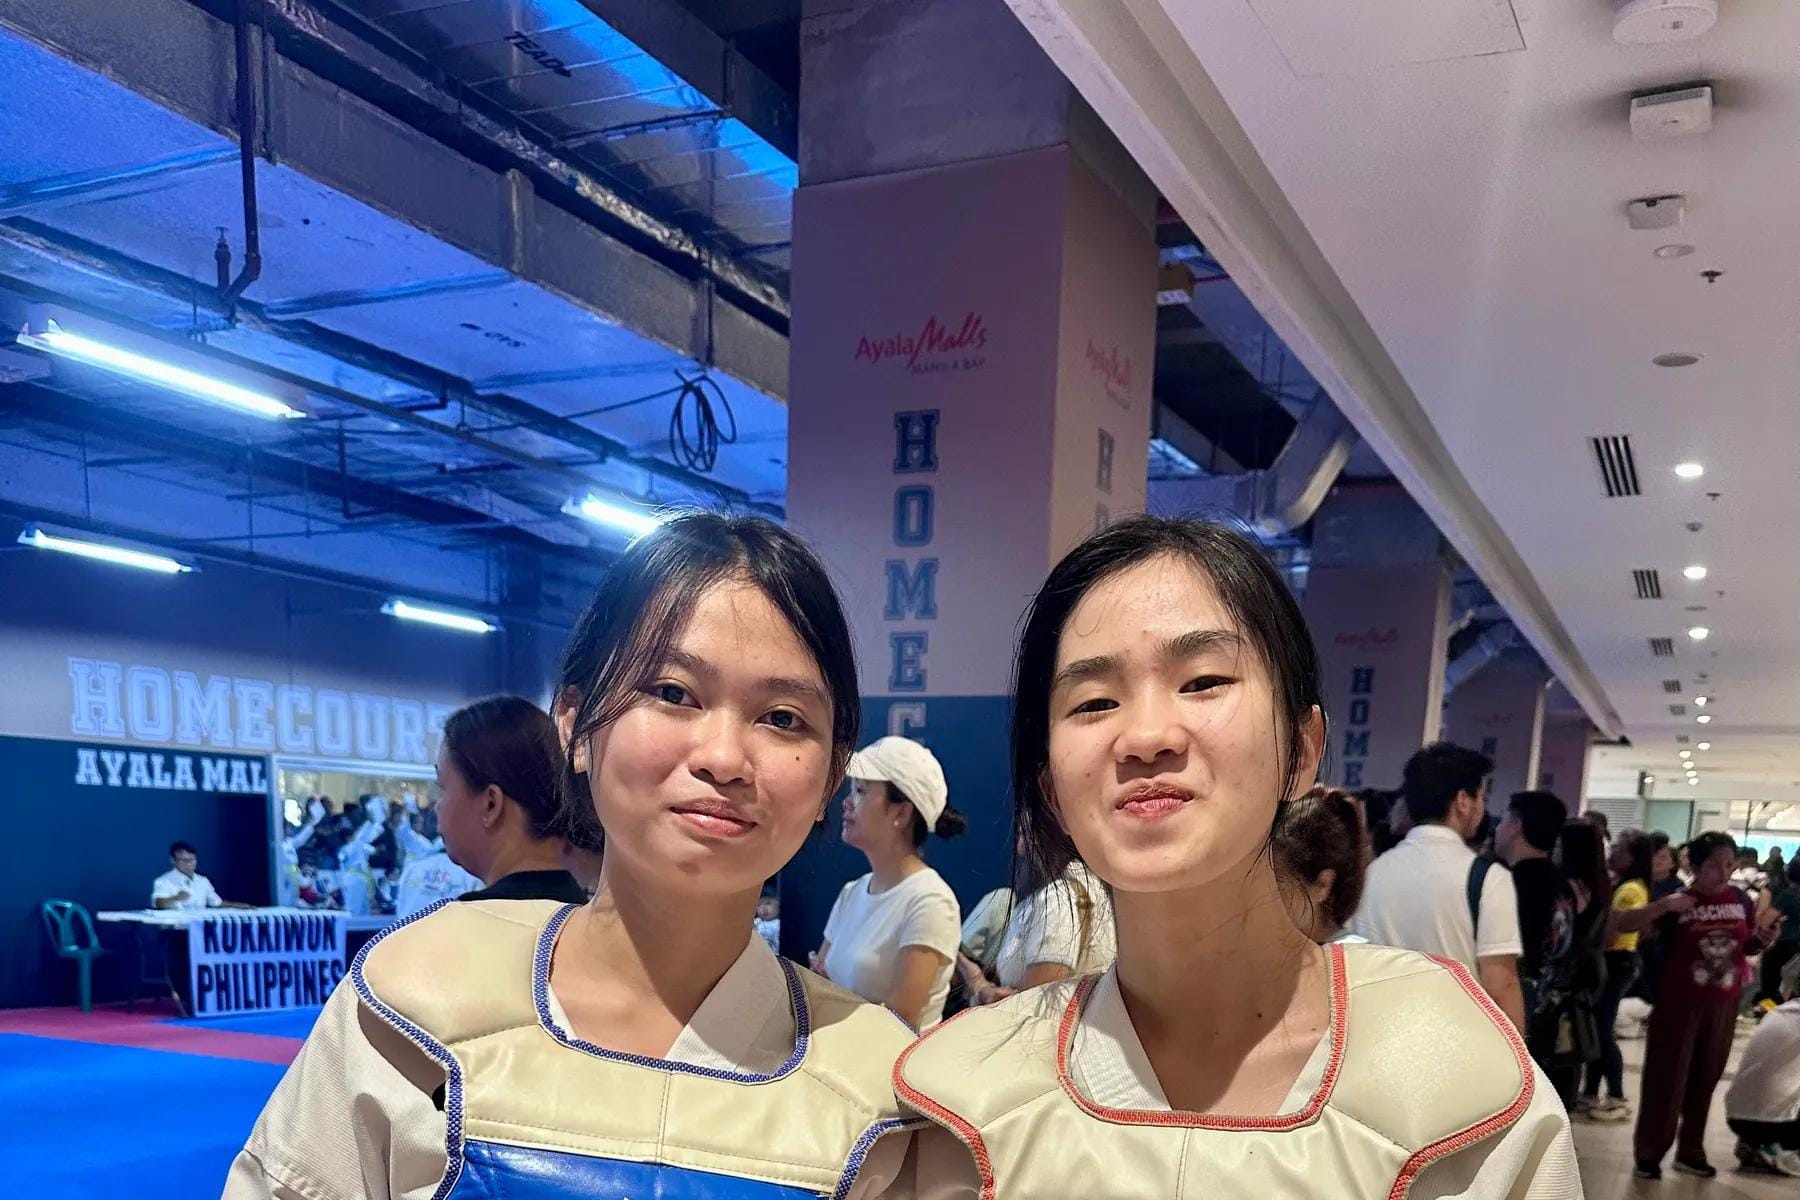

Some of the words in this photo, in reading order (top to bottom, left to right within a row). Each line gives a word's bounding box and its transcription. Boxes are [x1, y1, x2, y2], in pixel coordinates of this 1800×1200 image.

[854, 333, 913, 364] Ayala
[905, 311, 986, 370] Malls
[75, 748, 198, 790] AYALA
[201, 756, 268, 794] MAL
[197, 958, 345, 1012] PHILIPPINES
